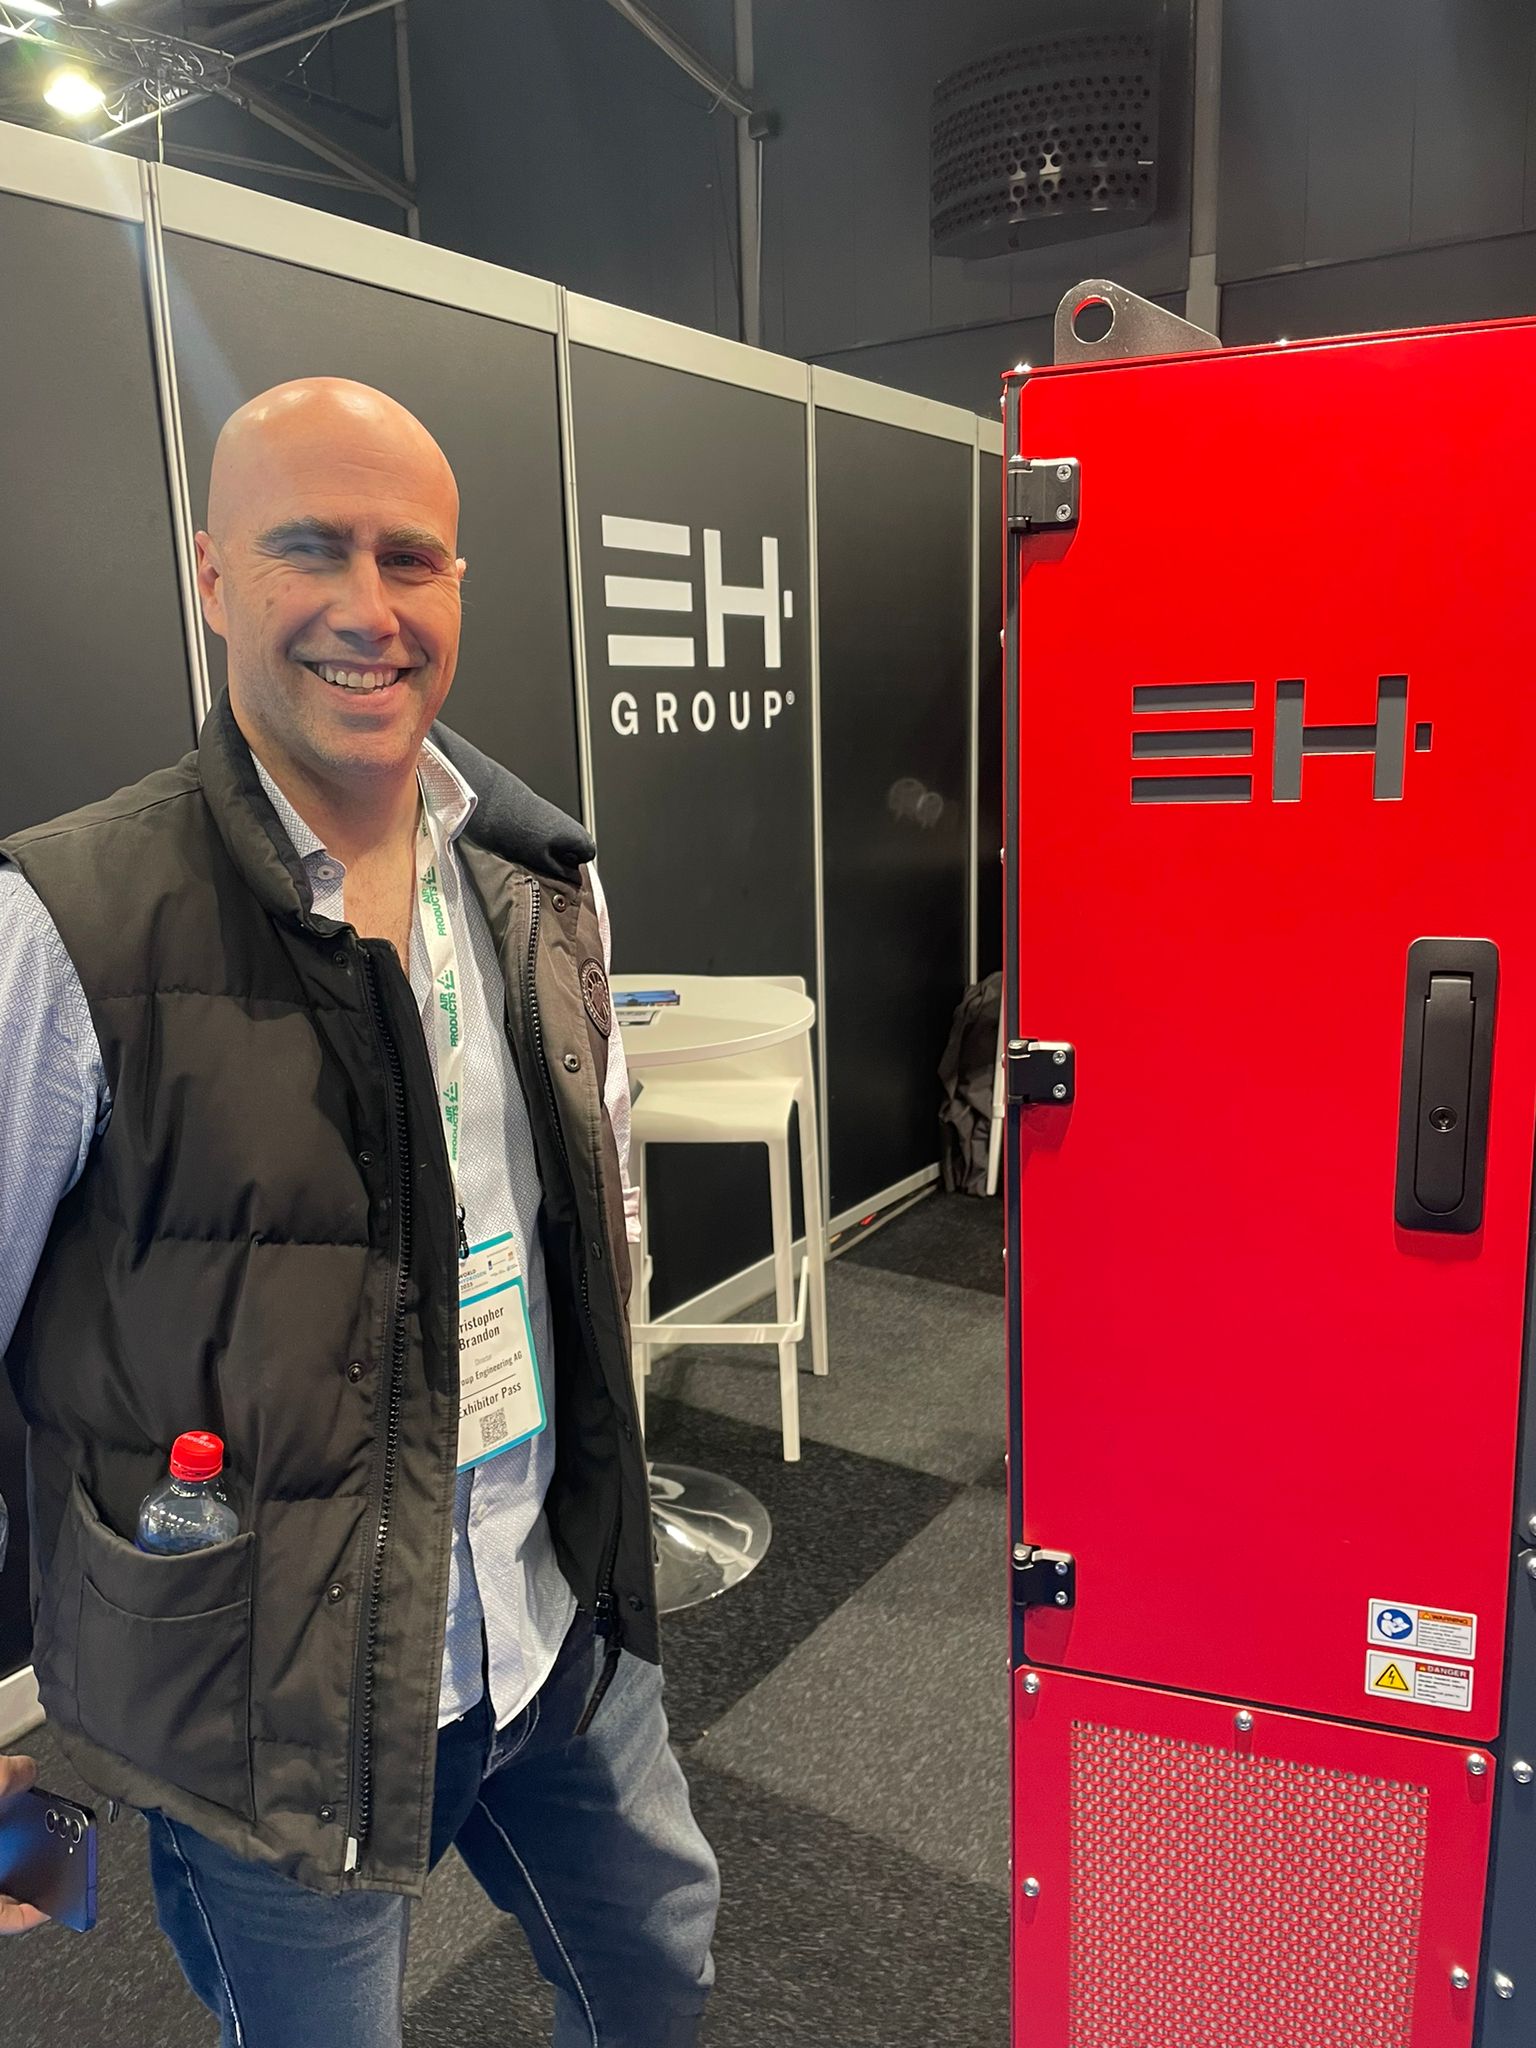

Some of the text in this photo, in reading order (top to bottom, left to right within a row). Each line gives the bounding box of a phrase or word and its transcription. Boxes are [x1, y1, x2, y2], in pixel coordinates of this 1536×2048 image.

[422, 888, 432, 904] AIR
[429, 886, 447, 936] PRODUCTS
[440, 992, 449, 1012] AIR
[447, 992, 458, 1047] PRODUCTS
[446, 1106, 454, 1124] AIR
[459, 1306, 504, 1334] ristopher
[458, 1326, 500, 1351] Brandon
[460, 1350, 523, 1386] oup Engineering AG
[501, 1382, 522, 1399] Pass
[1432, 1614, 1468, 1625] WARNING
[1427, 1665, 1468, 1678] DANGER
